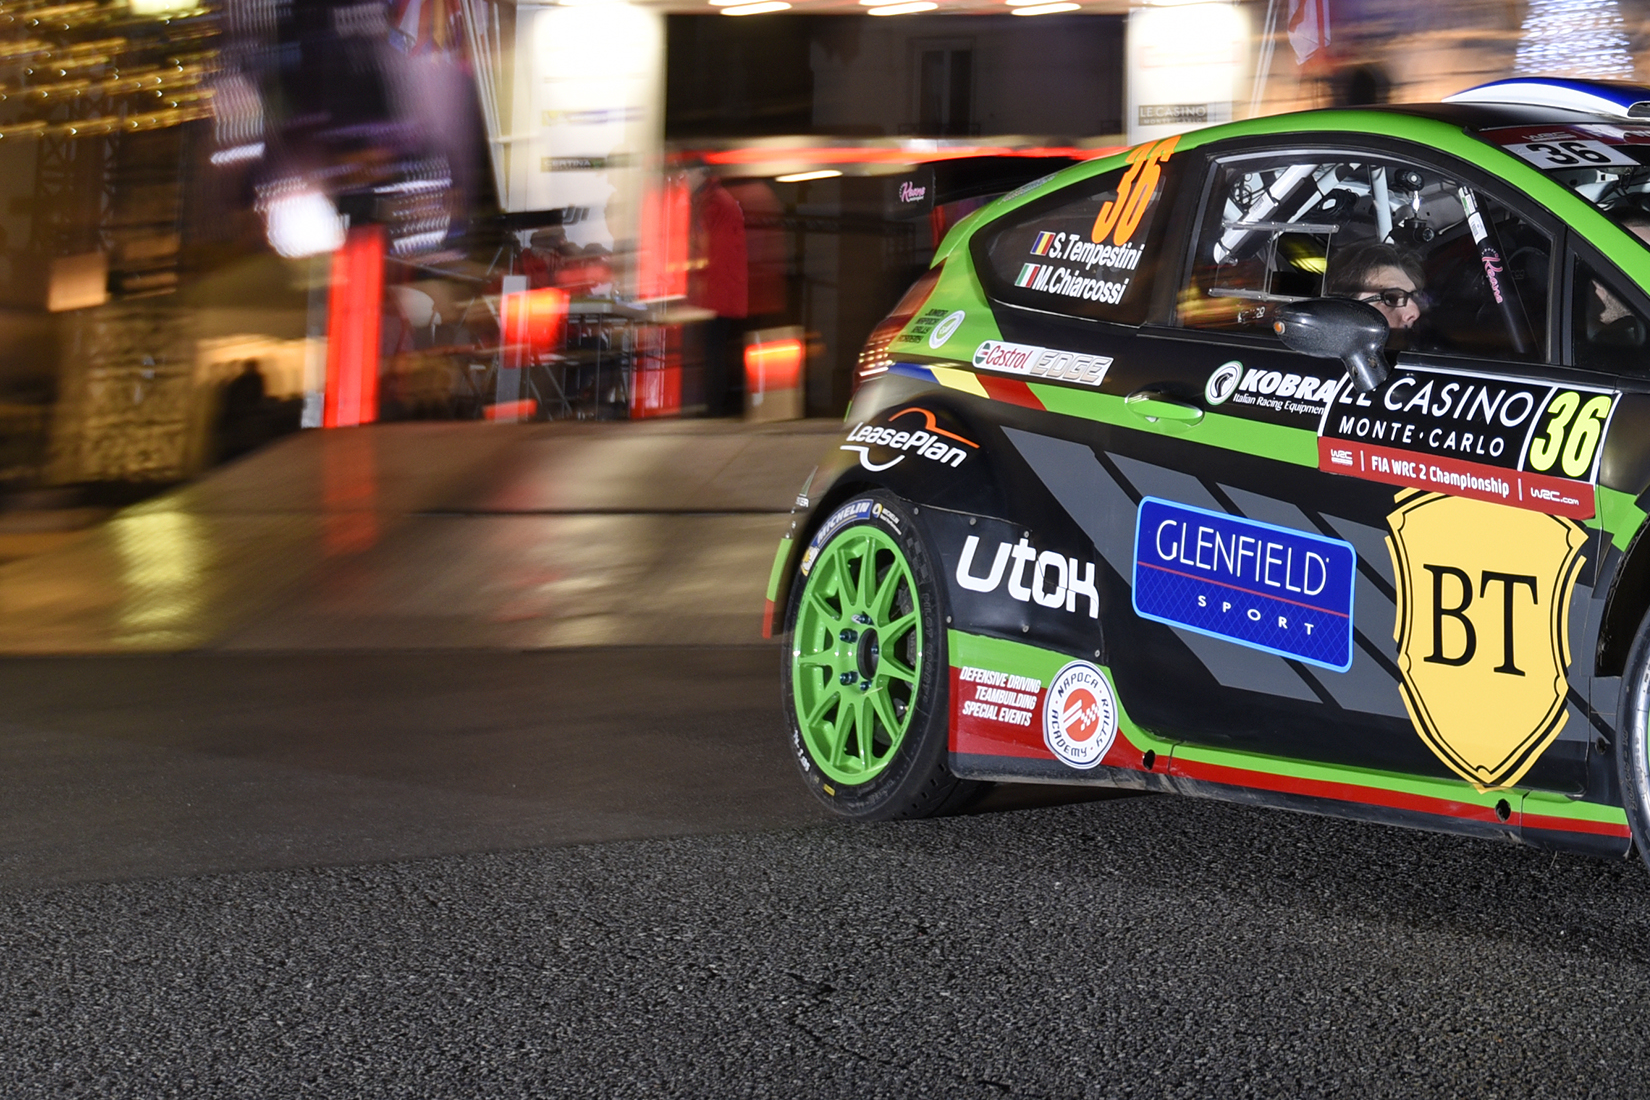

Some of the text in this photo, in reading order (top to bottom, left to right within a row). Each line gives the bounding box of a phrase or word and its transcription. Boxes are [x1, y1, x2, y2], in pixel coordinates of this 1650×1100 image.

[1140, 106, 1206, 117] LE CASINO
[1525, 141, 1612, 165] 36
[1091, 135, 1182, 246] 36
[1048, 231, 1145, 270] S.Tempestini
[1031, 264, 1130, 305] M.Chiarcossi
[985, 344, 1111, 383] Castrol EDGE
[1232, 393, 1325, 416] Italian Racing Equipmen
[1238, 368, 1338, 403] KOBRA
[1383, 377, 1535, 427] CASINO
[846, 422, 967, 468] LeasePlan
[1330, 448, 1353, 460] WRC
[1529, 390, 1612, 477] 36
[1371, 455, 1390, 474] FIA
[1392, 459, 1416, 479] WRC
[1418, 463, 1427, 479] 2
[1429, 467, 1510, 498] Championship
[817, 502, 870, 544] MICHELIN
[1156, 519, 1327, 596] GLENFIELD
[1197, 595, 1315, 636] SPORT
[1423, 563, 1539, 677] BT
[959, 666, 1041, 694] DEFENSIVE DRIVING
[974, 686, 1038, 710] TEAMBUILDING
[1058, 672, 1098, 698] NAPOCA
[962, 701, 1032, 727] SPECIAL EVENTS
[1051, 709, 1087, 758] ACADEMY
[1096, 698, 1110, 747] RALLY
